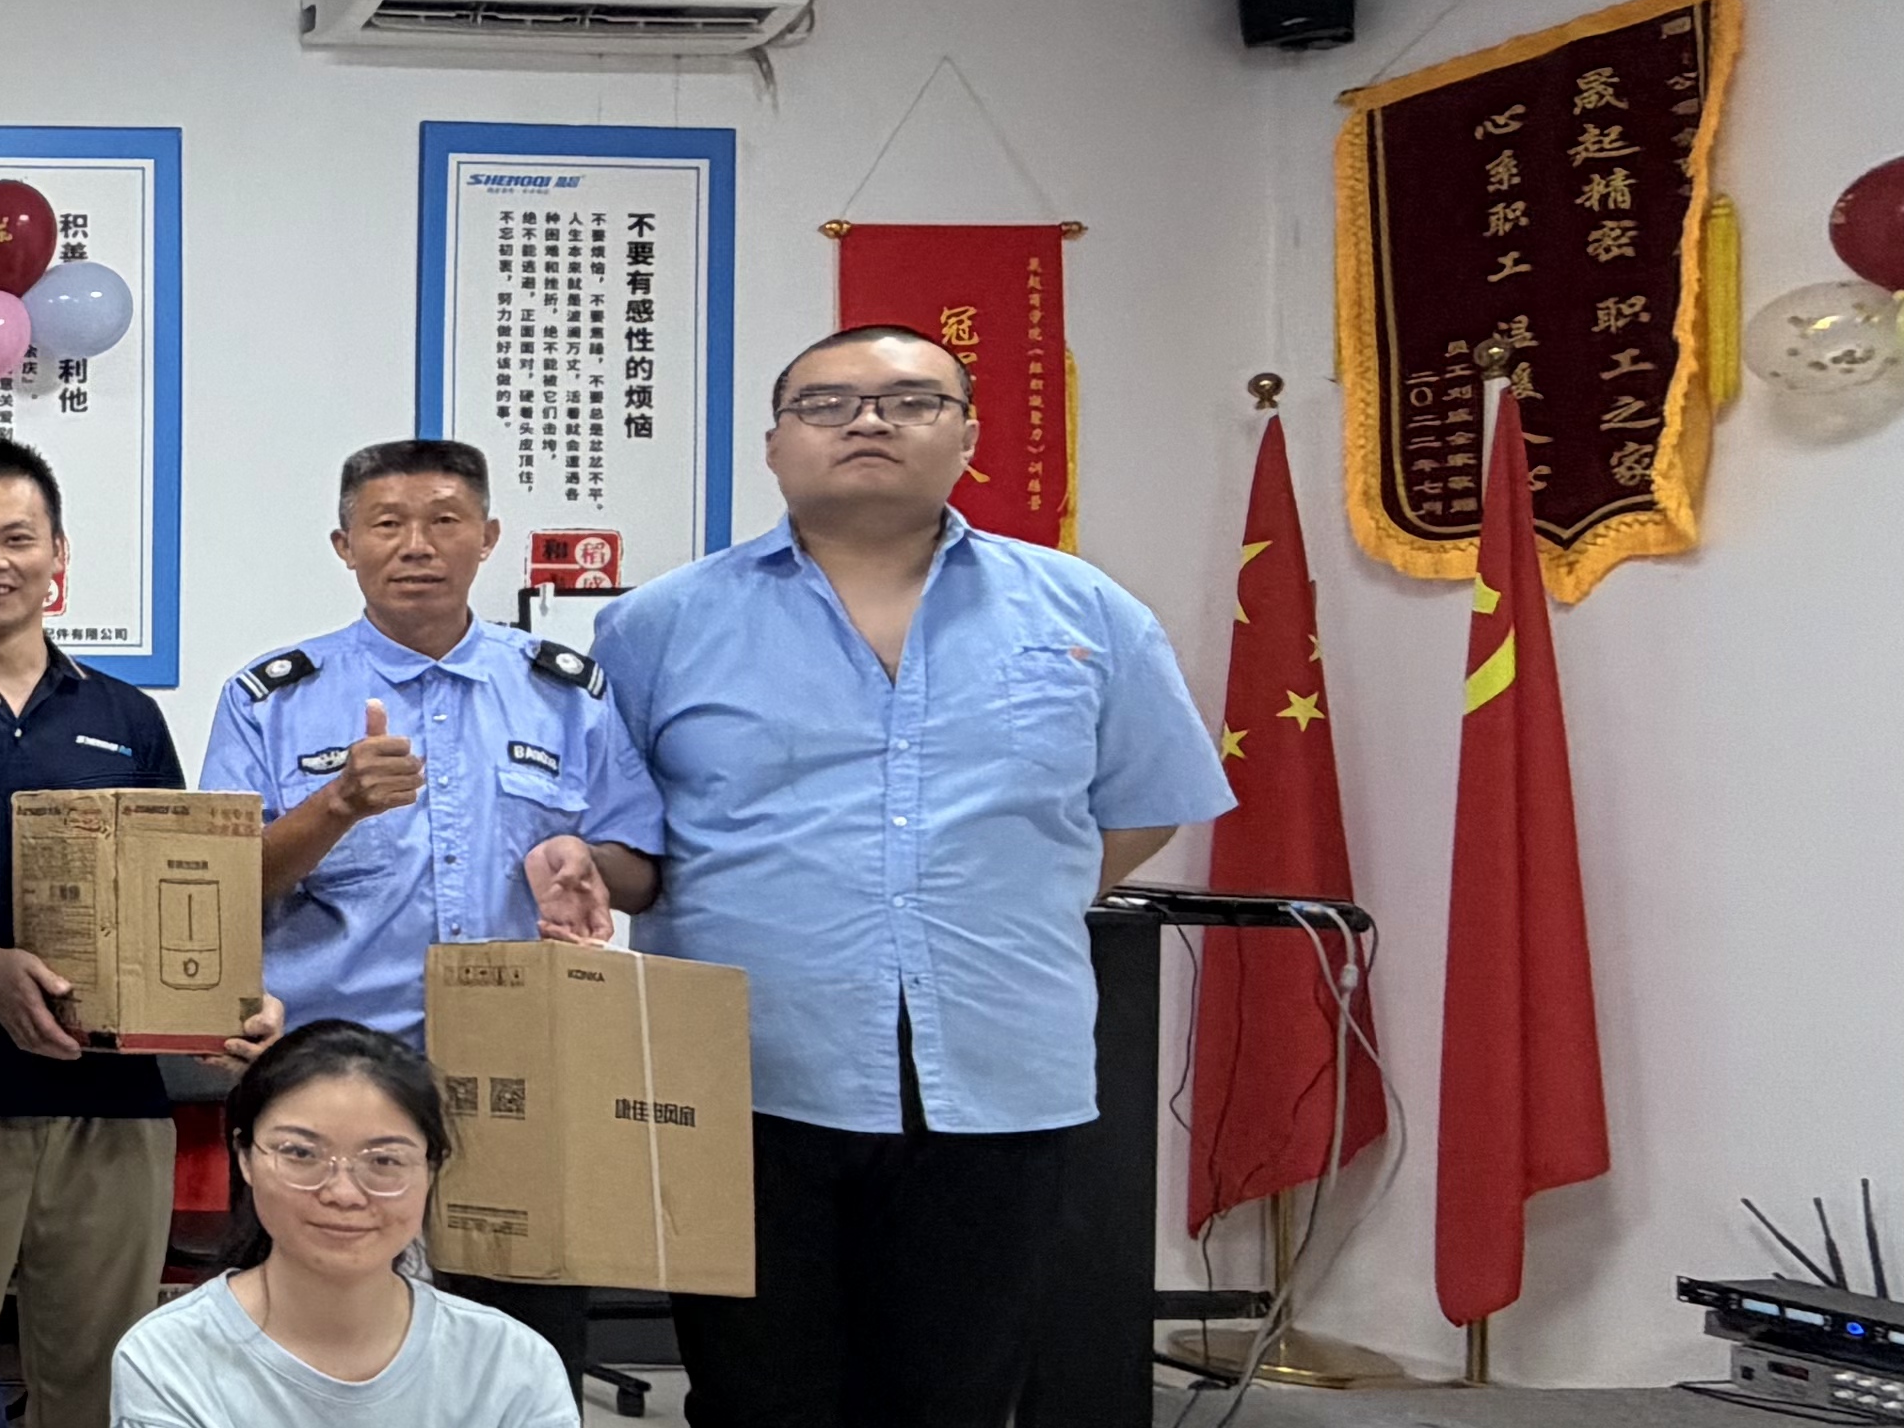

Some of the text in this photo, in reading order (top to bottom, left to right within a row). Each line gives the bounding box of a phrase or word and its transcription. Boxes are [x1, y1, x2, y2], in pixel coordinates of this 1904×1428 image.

[58, 358, 89, 414] 利他
[624, 212, 657, 439] 不要有感性的烦恼
[1590, 294, 1661, 487] 职工之家
